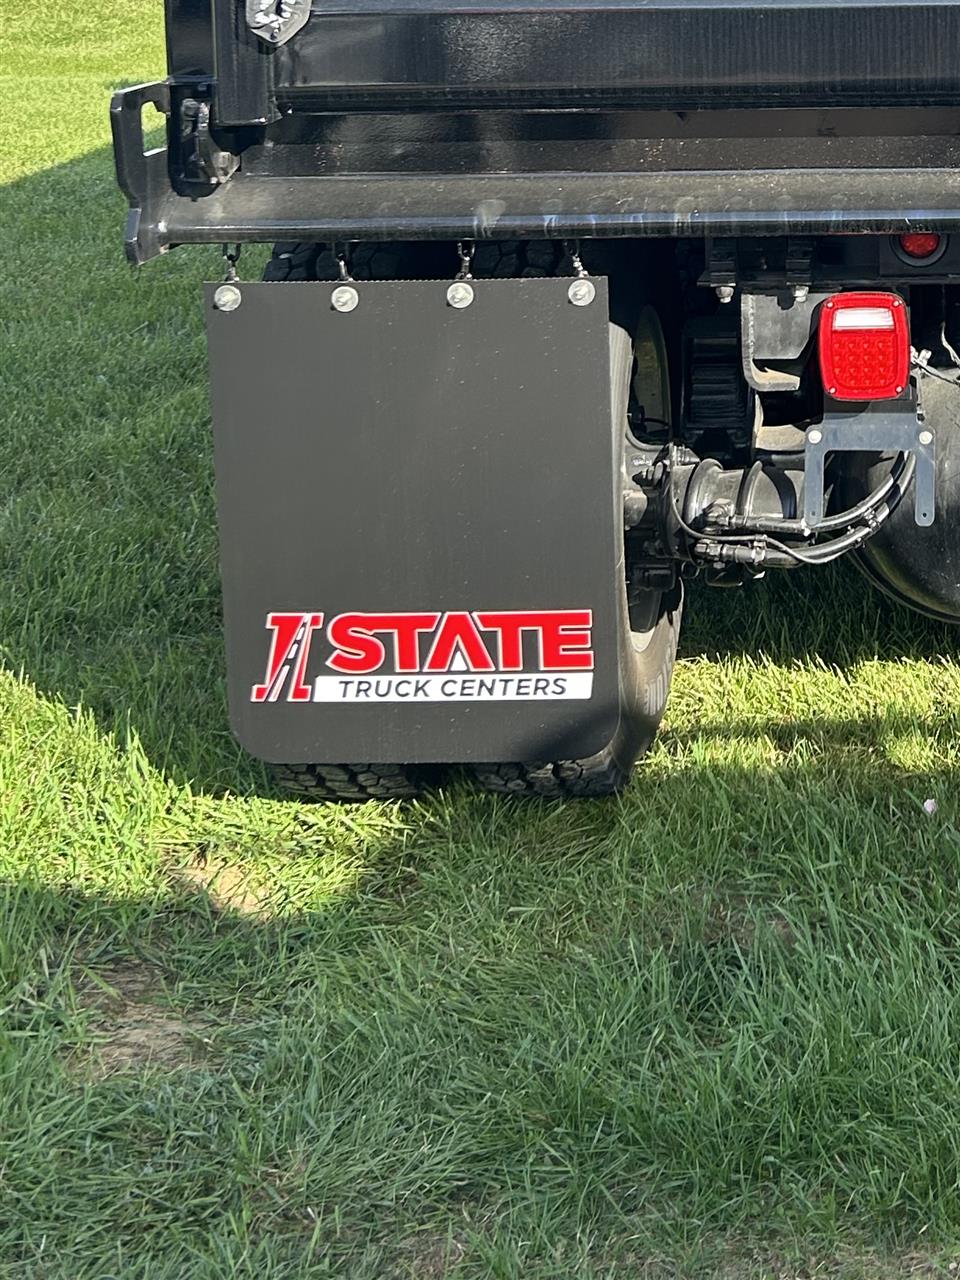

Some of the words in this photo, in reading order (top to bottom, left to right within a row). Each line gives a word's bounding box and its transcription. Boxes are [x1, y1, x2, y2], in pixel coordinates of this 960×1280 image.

[325, 609, 594, 674] STATE
[338, 679, 431, 699] TRUCK
[441, 677, 567, 697] CENTERS
